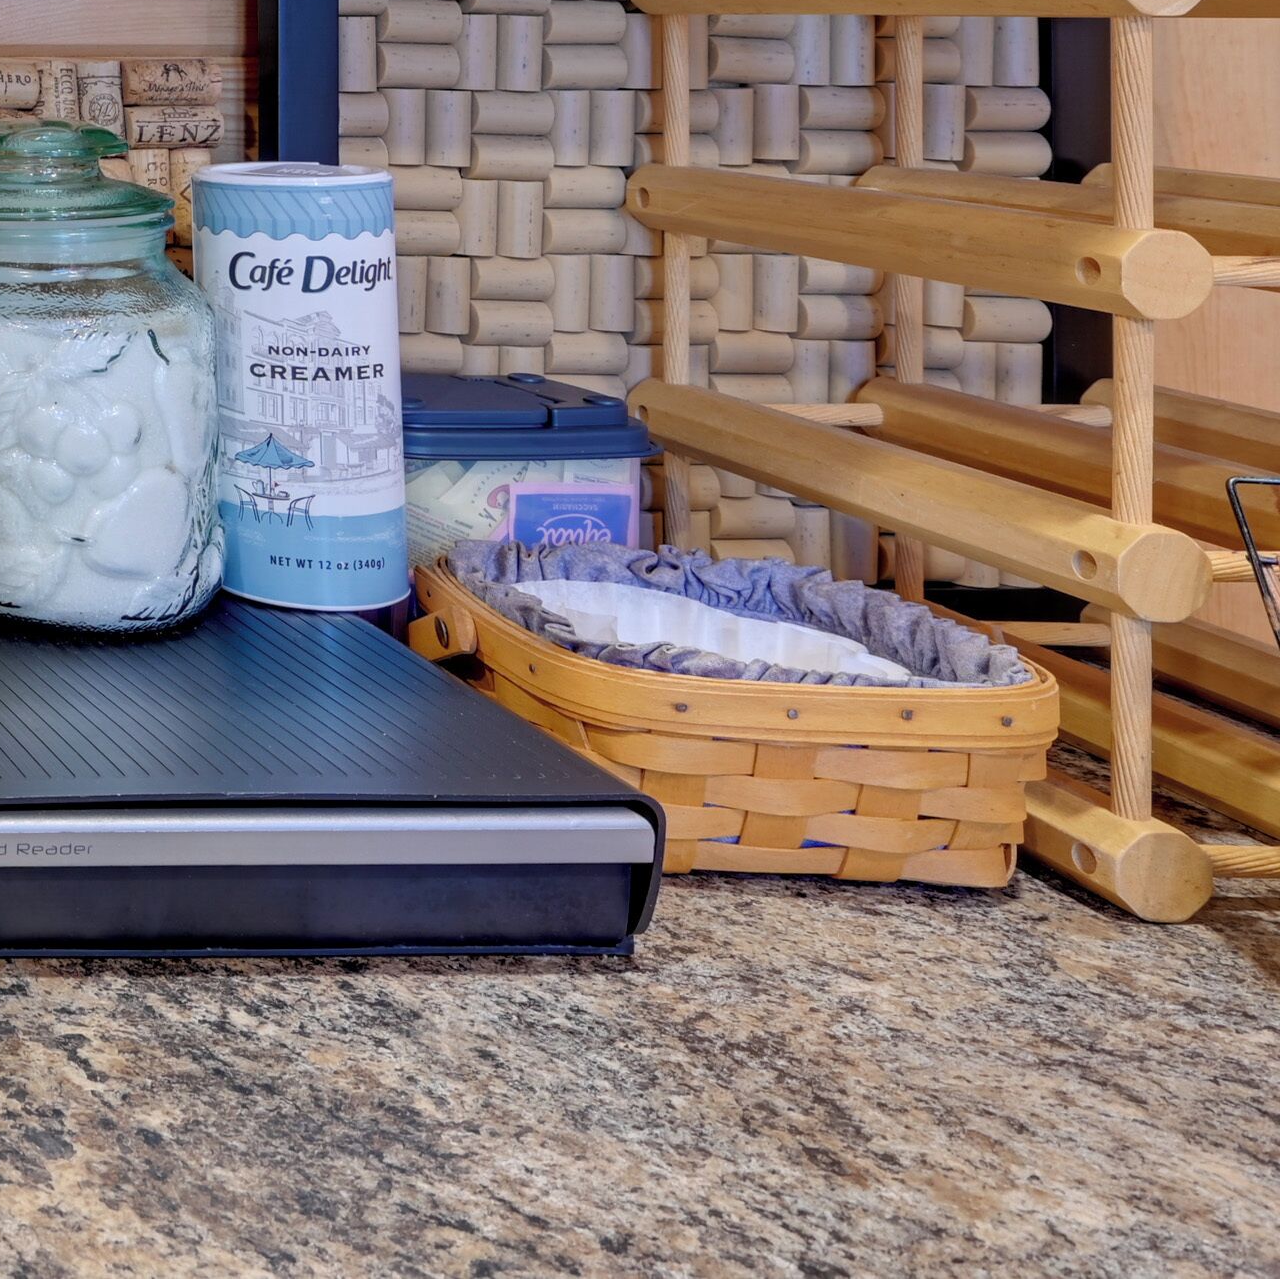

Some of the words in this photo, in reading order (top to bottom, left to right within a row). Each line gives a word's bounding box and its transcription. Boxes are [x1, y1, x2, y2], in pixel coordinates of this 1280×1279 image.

[136, 122, 221, 145] LENZ
[228, 251, 295, 292] Café
[301, 255, 392, 294] Delight
[268, 345, 371, 357] NON-DAIRY
[249, 362, 385, 382] CREAMER
[269, 554, 292, 568] NET
[295, 558, 314, 569] WT
[318, 560, 332, 570] 12
[336, 561, 349, 570] oz
[353, 557, 386, 571] (340g)
[16, 842, 93, 856] Reader
